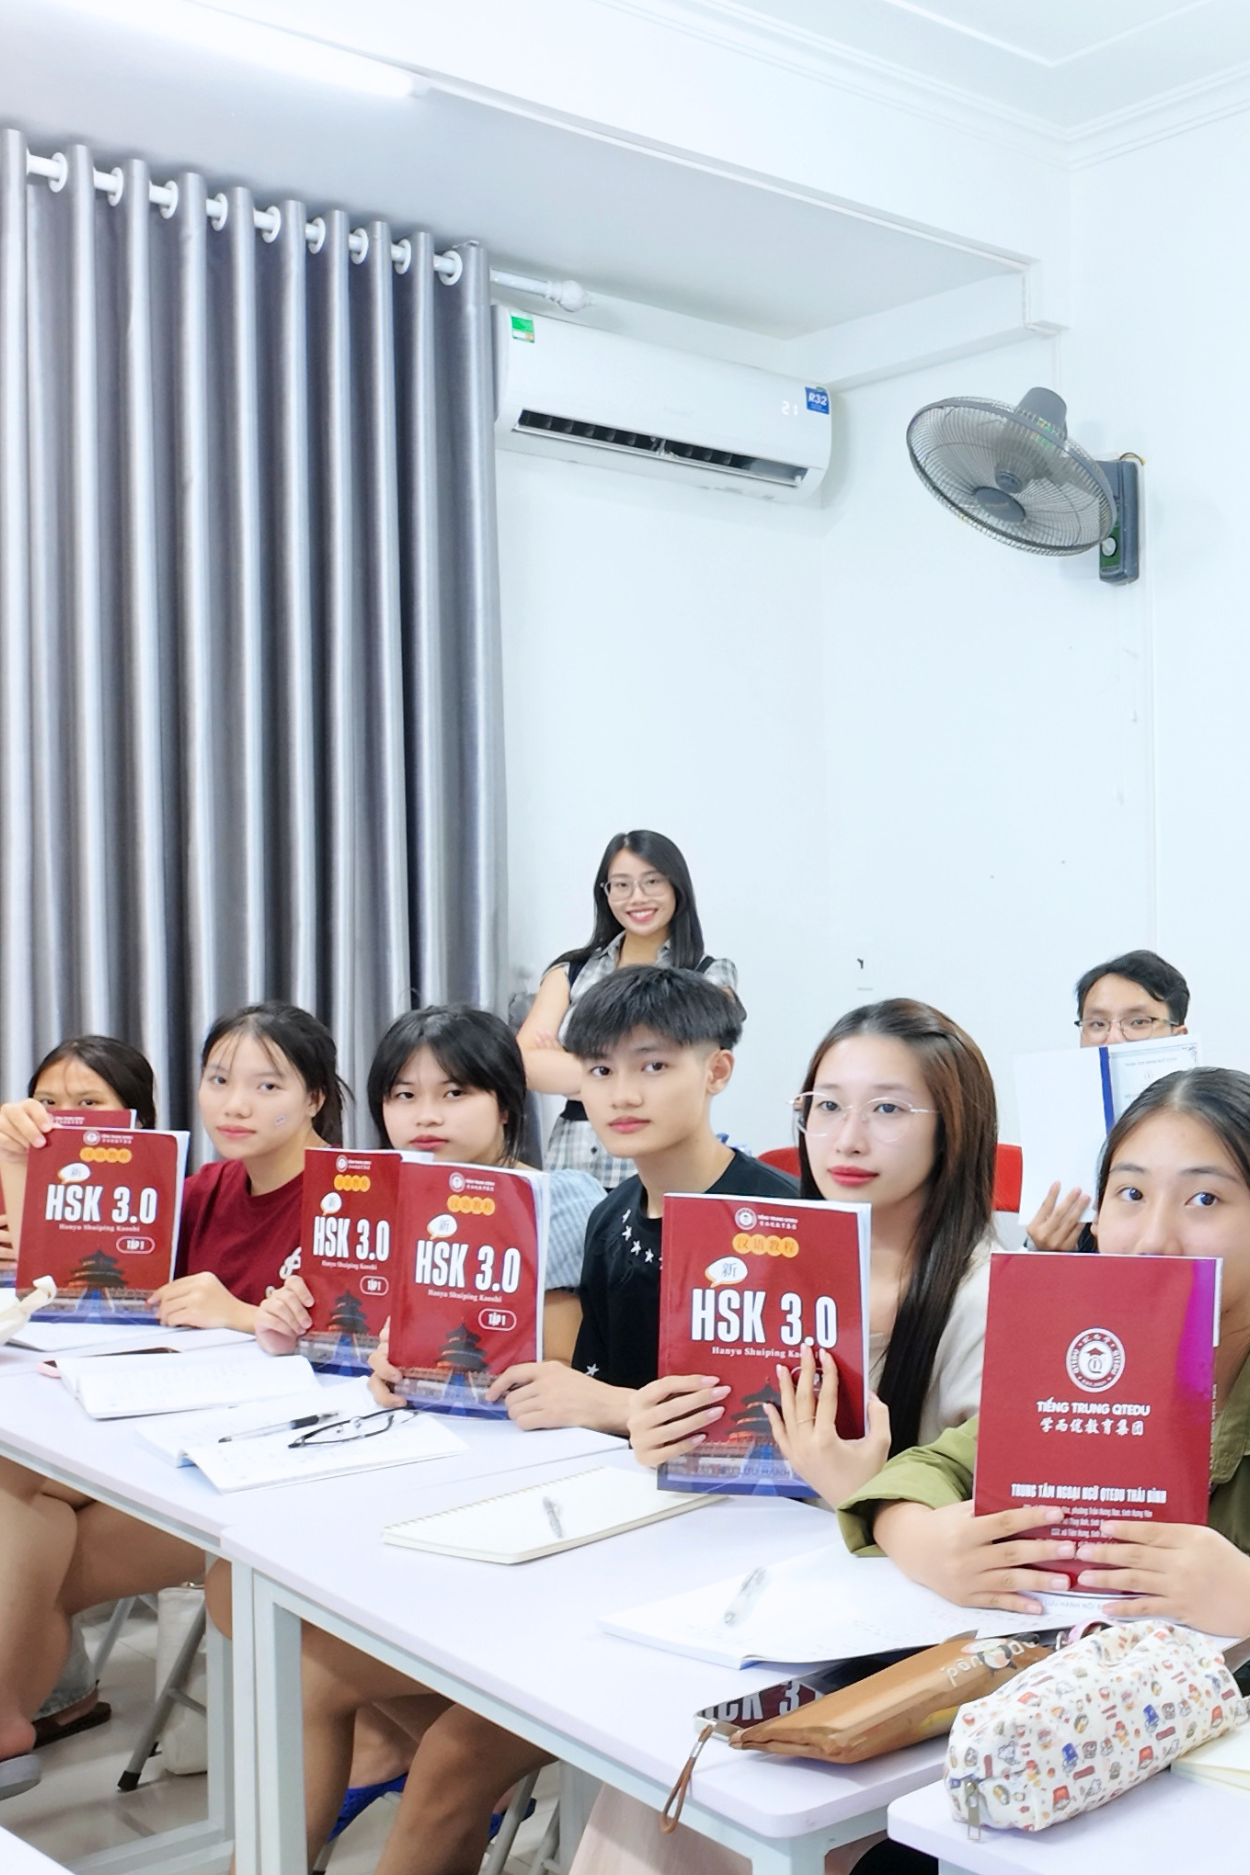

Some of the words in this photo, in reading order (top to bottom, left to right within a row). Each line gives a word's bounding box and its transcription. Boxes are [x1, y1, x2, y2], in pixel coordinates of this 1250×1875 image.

[45, 1184, 103, 1222] HSK
[111, 1186, 158, 1224] 3.0
[313, 1215, 351, 1258] HSK
[356, 1218, 390, 1262] 3.0
[415, 1240, 469, 1288] HSK
[475, 1245, 521, 1294] 3.0
[691, 1288, 767, 1343] HSK
[780, 1292, 838, 1349] 3.0
[712, 1346, 742, 1358] Hanyu
[744, 1347, 786, 1359] Shuiping
[1036, 1397, 1069, 1414] TIẾNG
[1071, 1401, 1110, 1415] TRUNG
[1112, 1403, 1151, 1417] QTEDU
